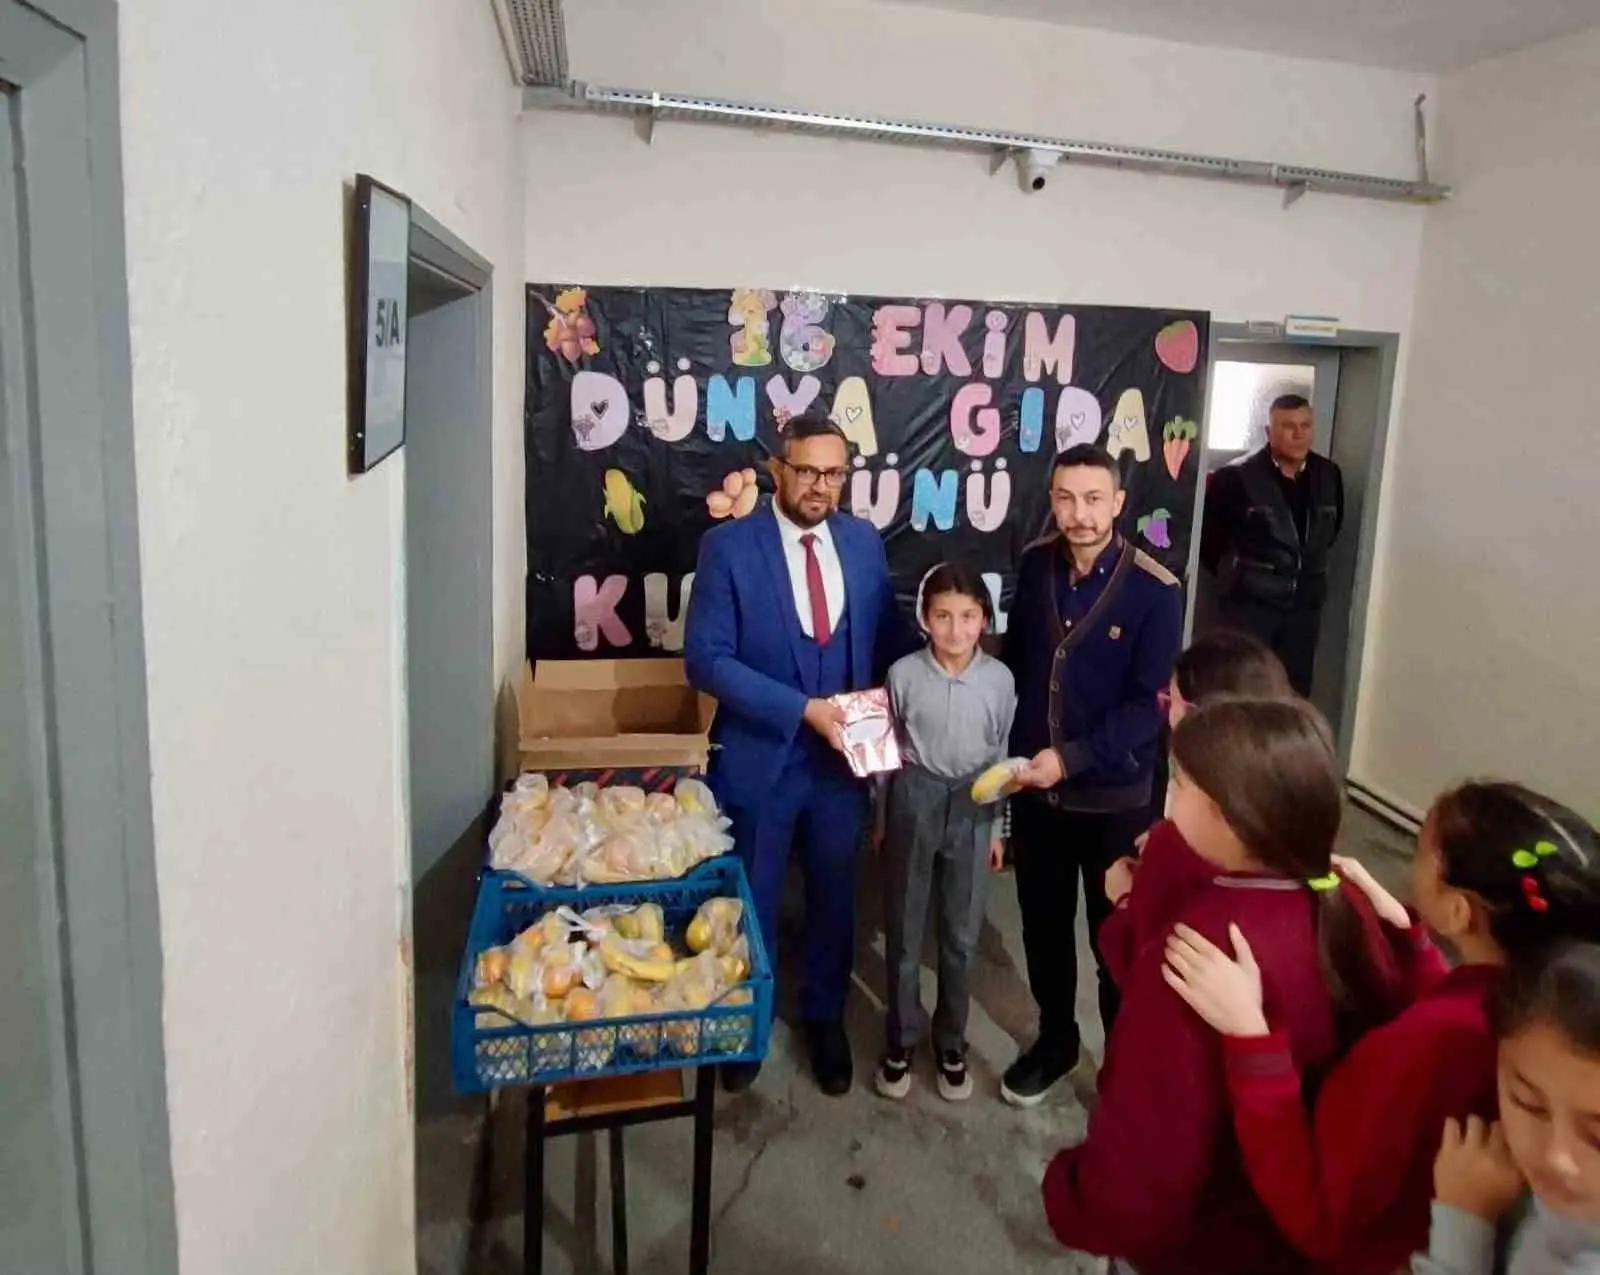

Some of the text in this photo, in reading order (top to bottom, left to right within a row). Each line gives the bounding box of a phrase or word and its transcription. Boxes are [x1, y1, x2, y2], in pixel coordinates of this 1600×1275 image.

[376, 299, 400, 347] 5/A
[728, 288, 835, 372] 16
[571, 357, 1151, 462] DÜNYA GIDA
[851, 453, 1011, 532] ÜNÜ
